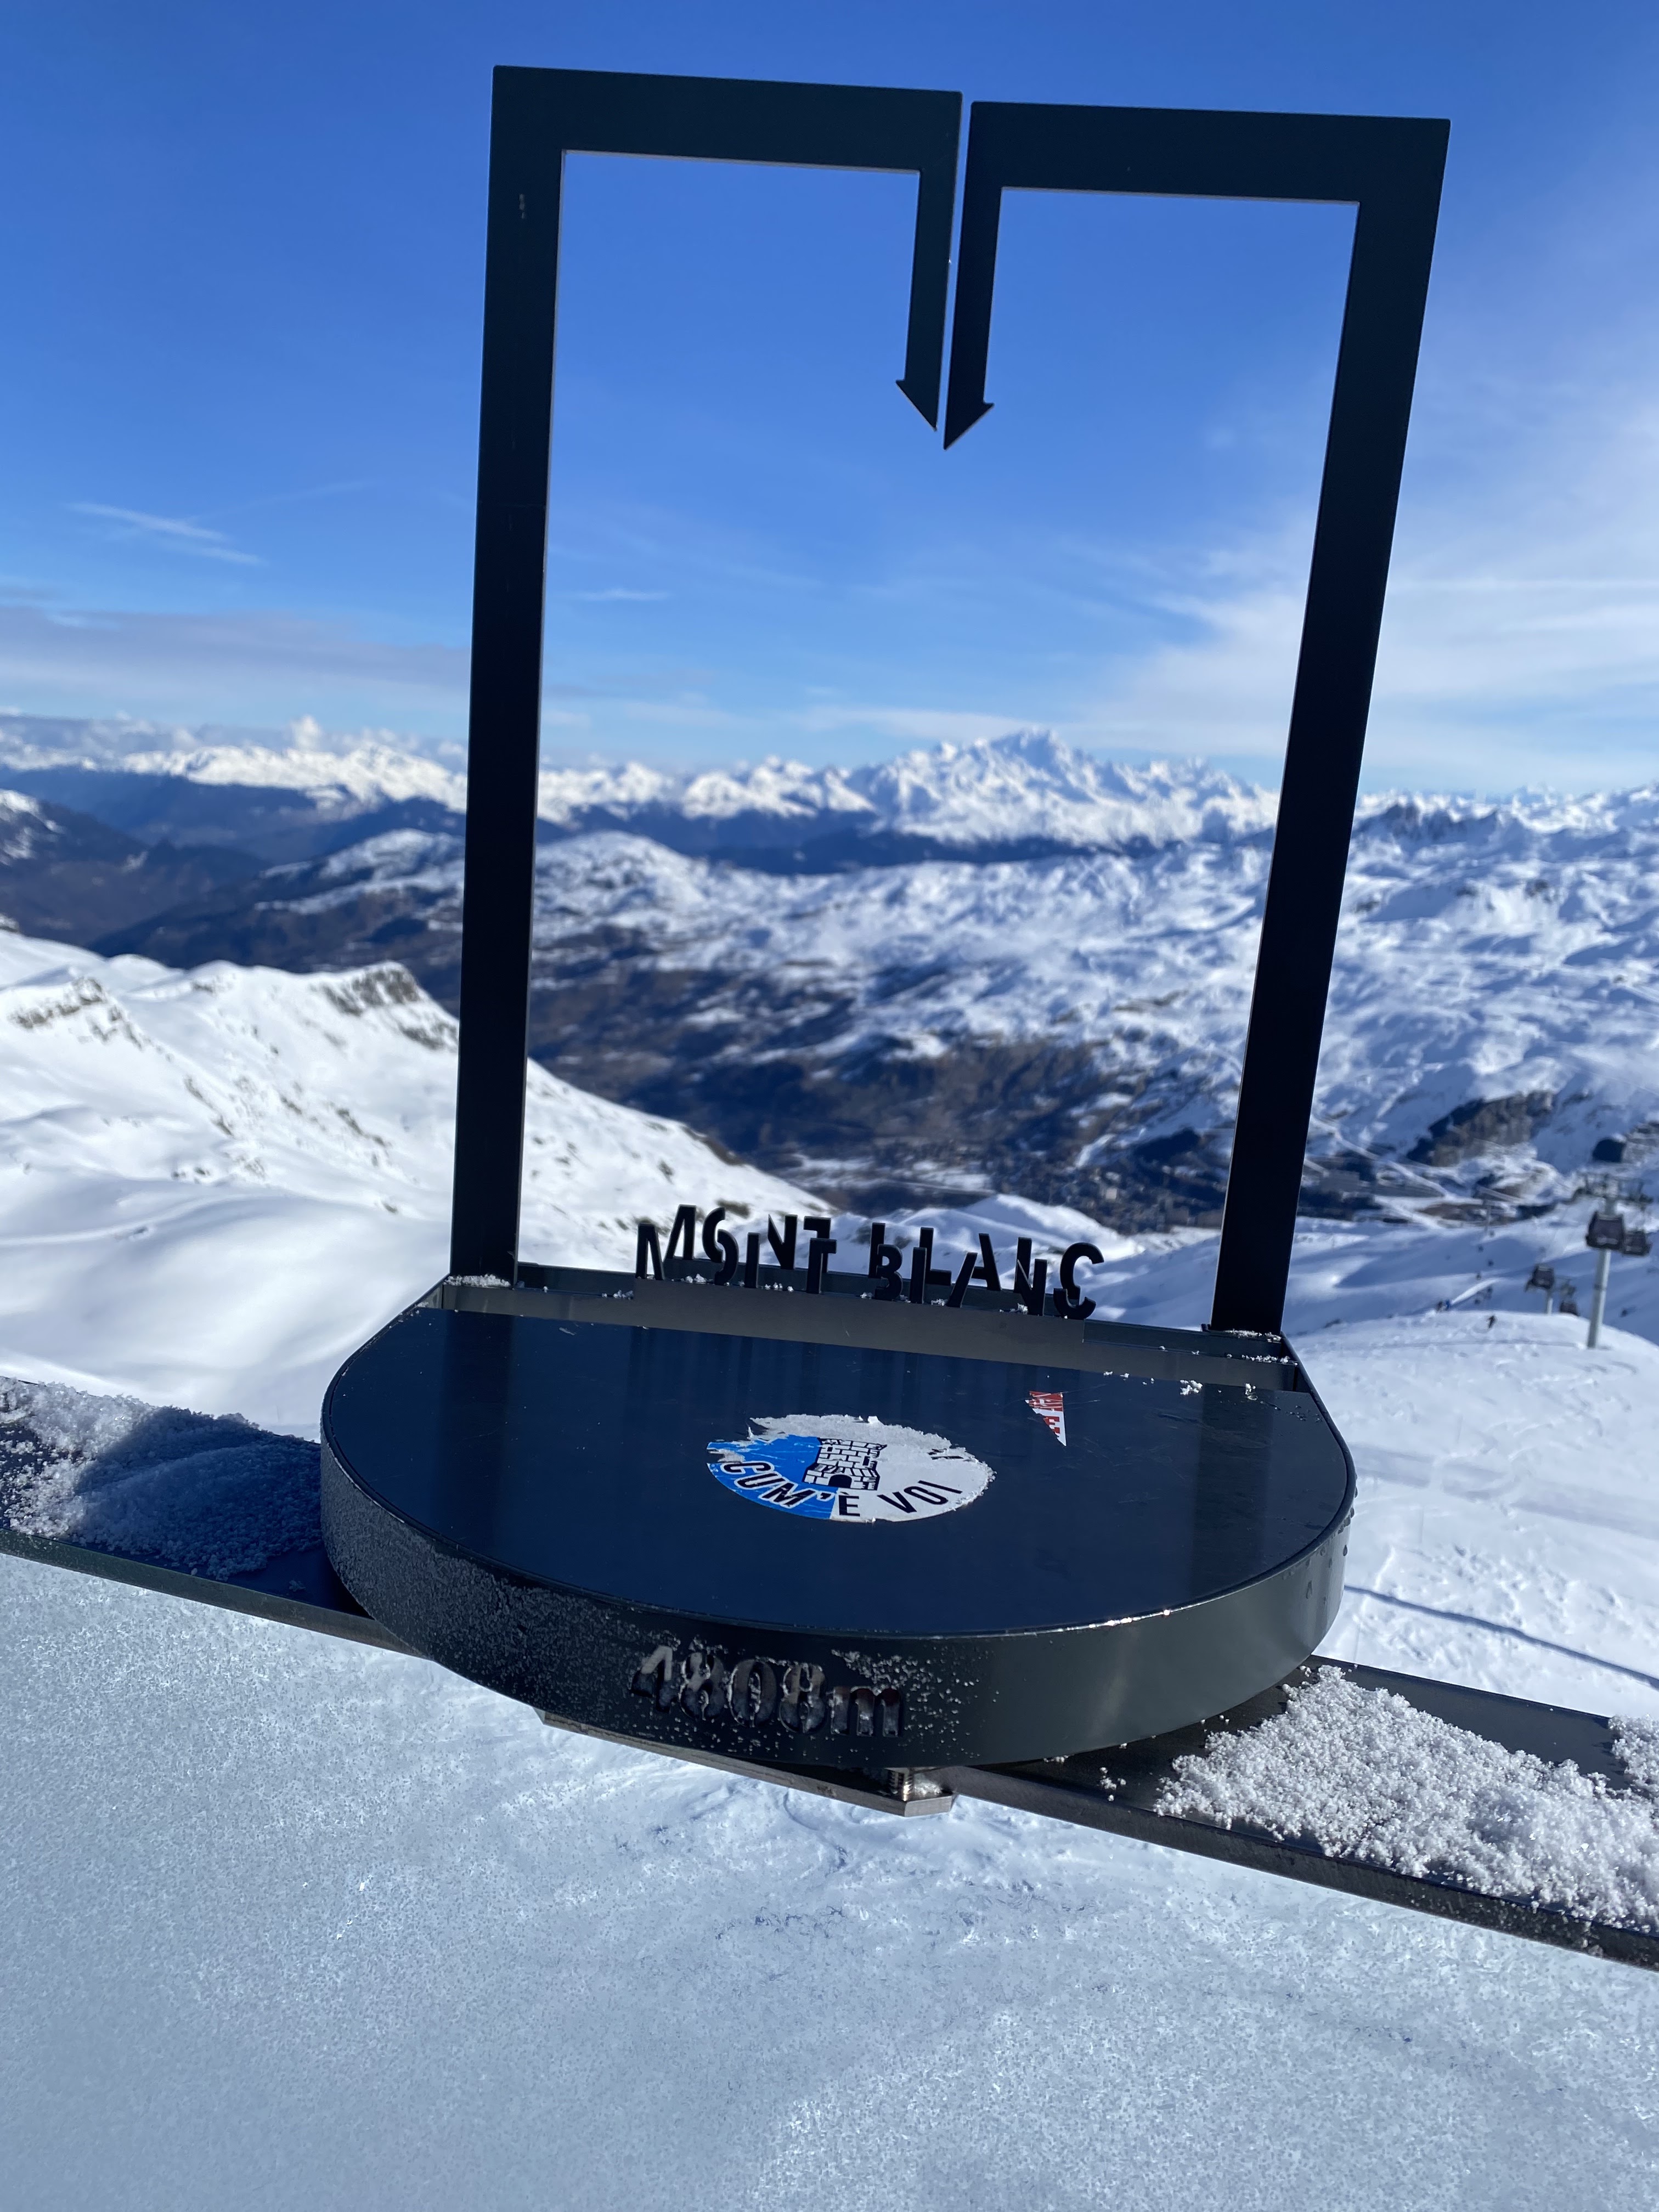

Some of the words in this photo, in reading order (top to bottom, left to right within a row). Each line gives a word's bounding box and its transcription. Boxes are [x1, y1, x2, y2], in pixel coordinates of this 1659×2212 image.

[636, 1204, 837, 1294] MONT
[868, 1222, 1104, 1319] BLANC
[877, 1480, 963, 1513] VOI
[630, 1645, 902, 1738] 4808m
